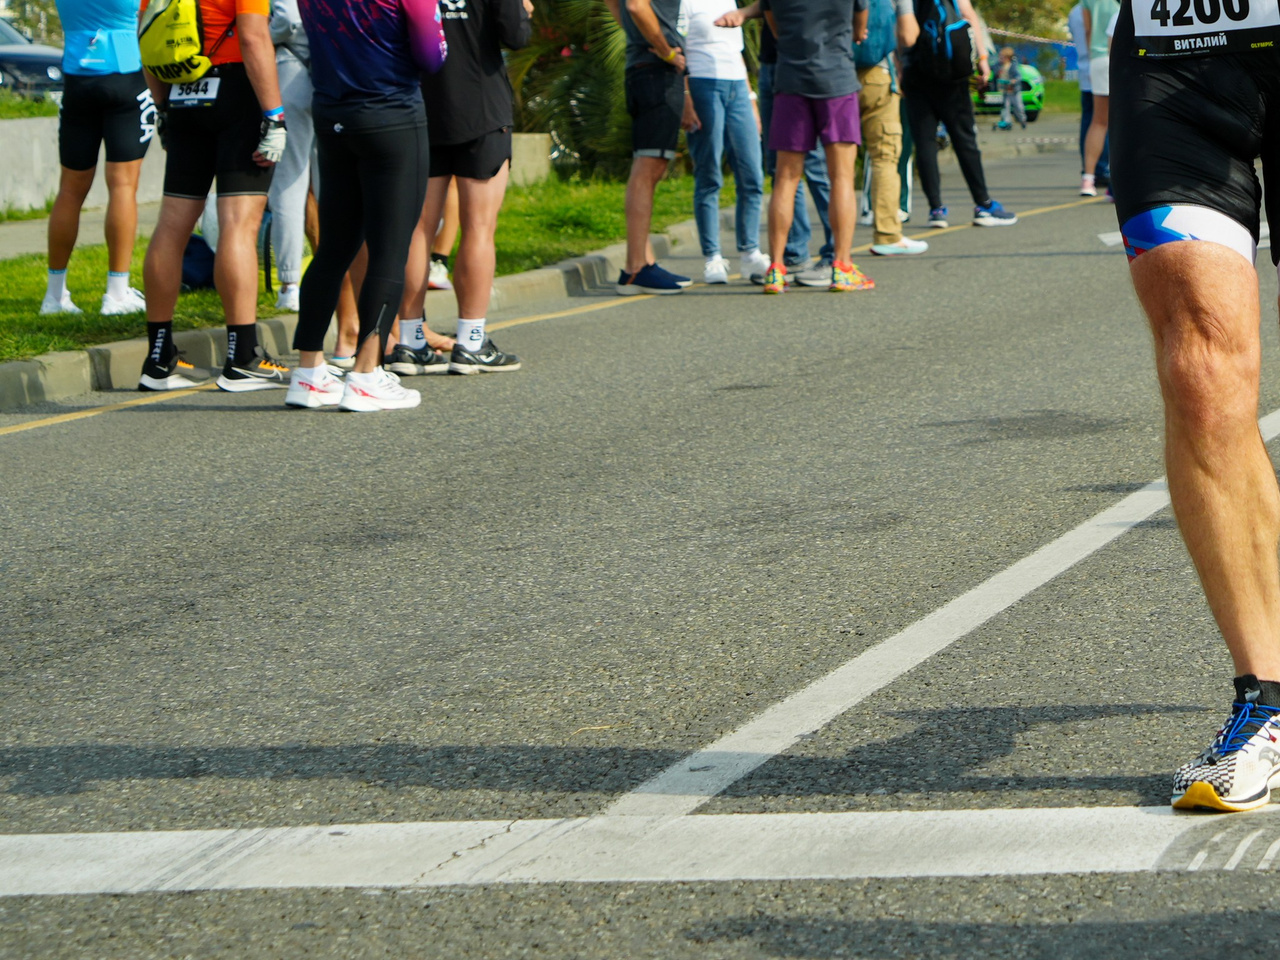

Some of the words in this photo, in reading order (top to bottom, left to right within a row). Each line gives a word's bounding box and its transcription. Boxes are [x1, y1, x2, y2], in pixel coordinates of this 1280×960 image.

[1174, 33, 1228, 50] ВИТАЛИЙ
[1250, 41, 1274, 49] OLYMPIC
[178, 81, 209, 96] 5644
